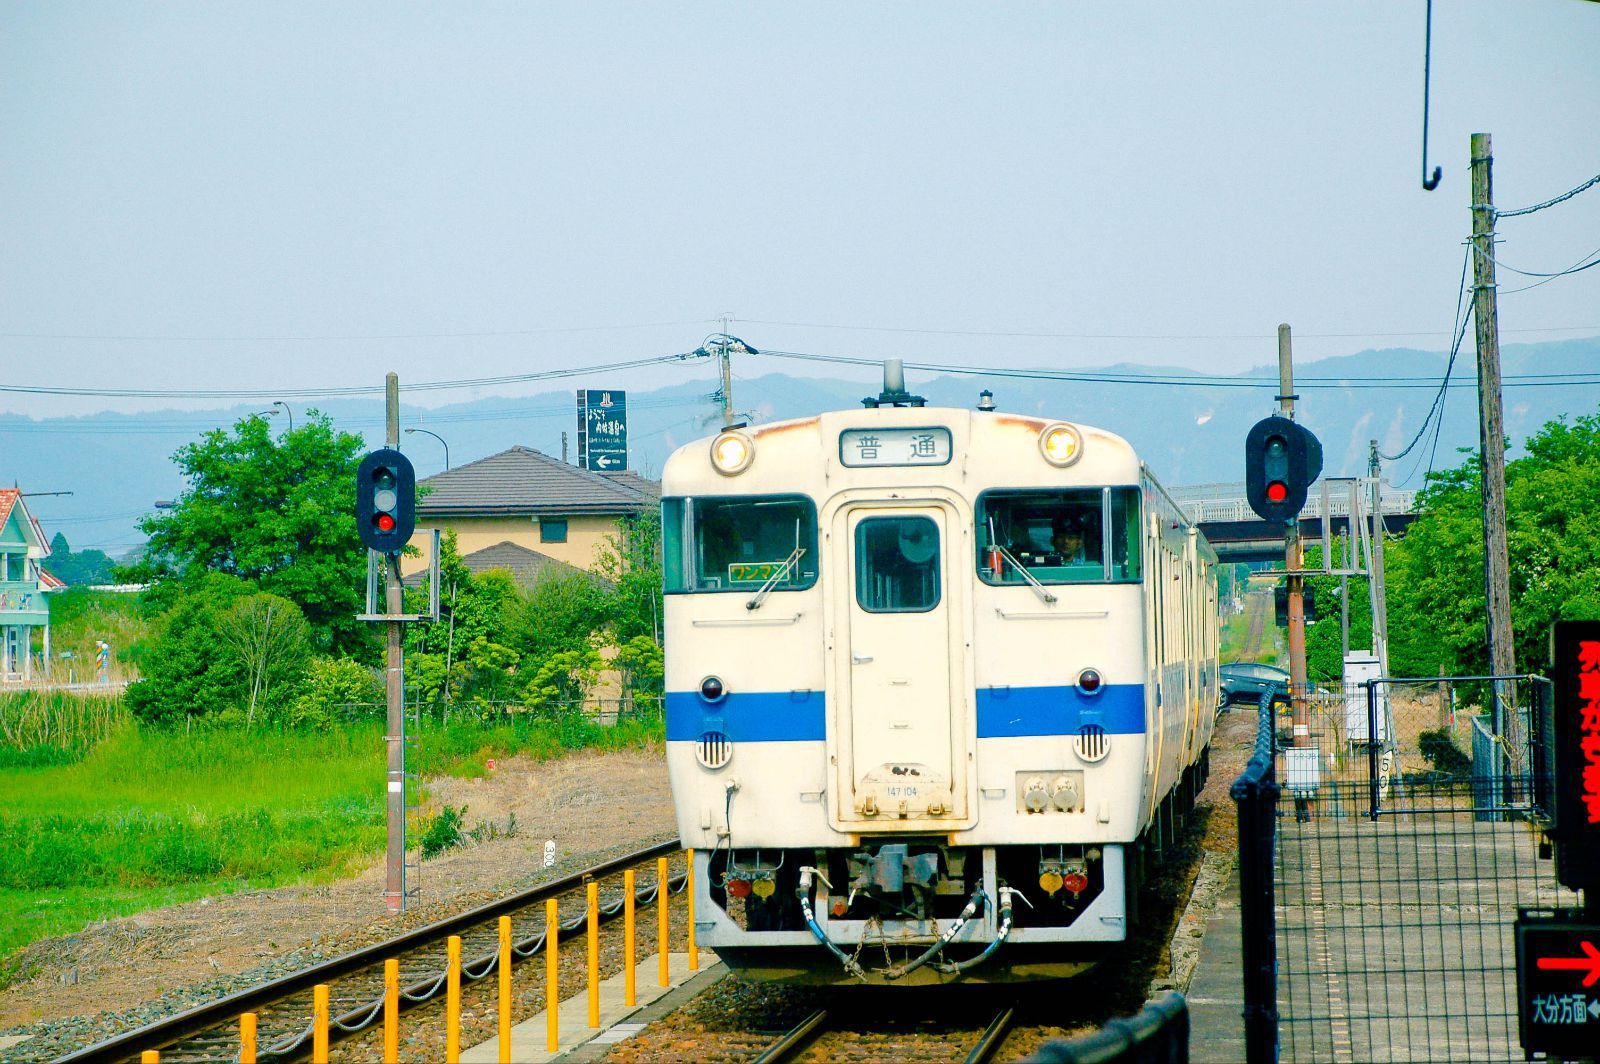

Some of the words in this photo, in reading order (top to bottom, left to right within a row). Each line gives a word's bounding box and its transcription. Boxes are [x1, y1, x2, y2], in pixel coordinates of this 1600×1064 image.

[856, 435, 937, 459] 普通
[1380, 758, 1389, 789] 50
[545, 846, 555, 867] 300
[1533, 993, 1587, 1024] 大分方面
